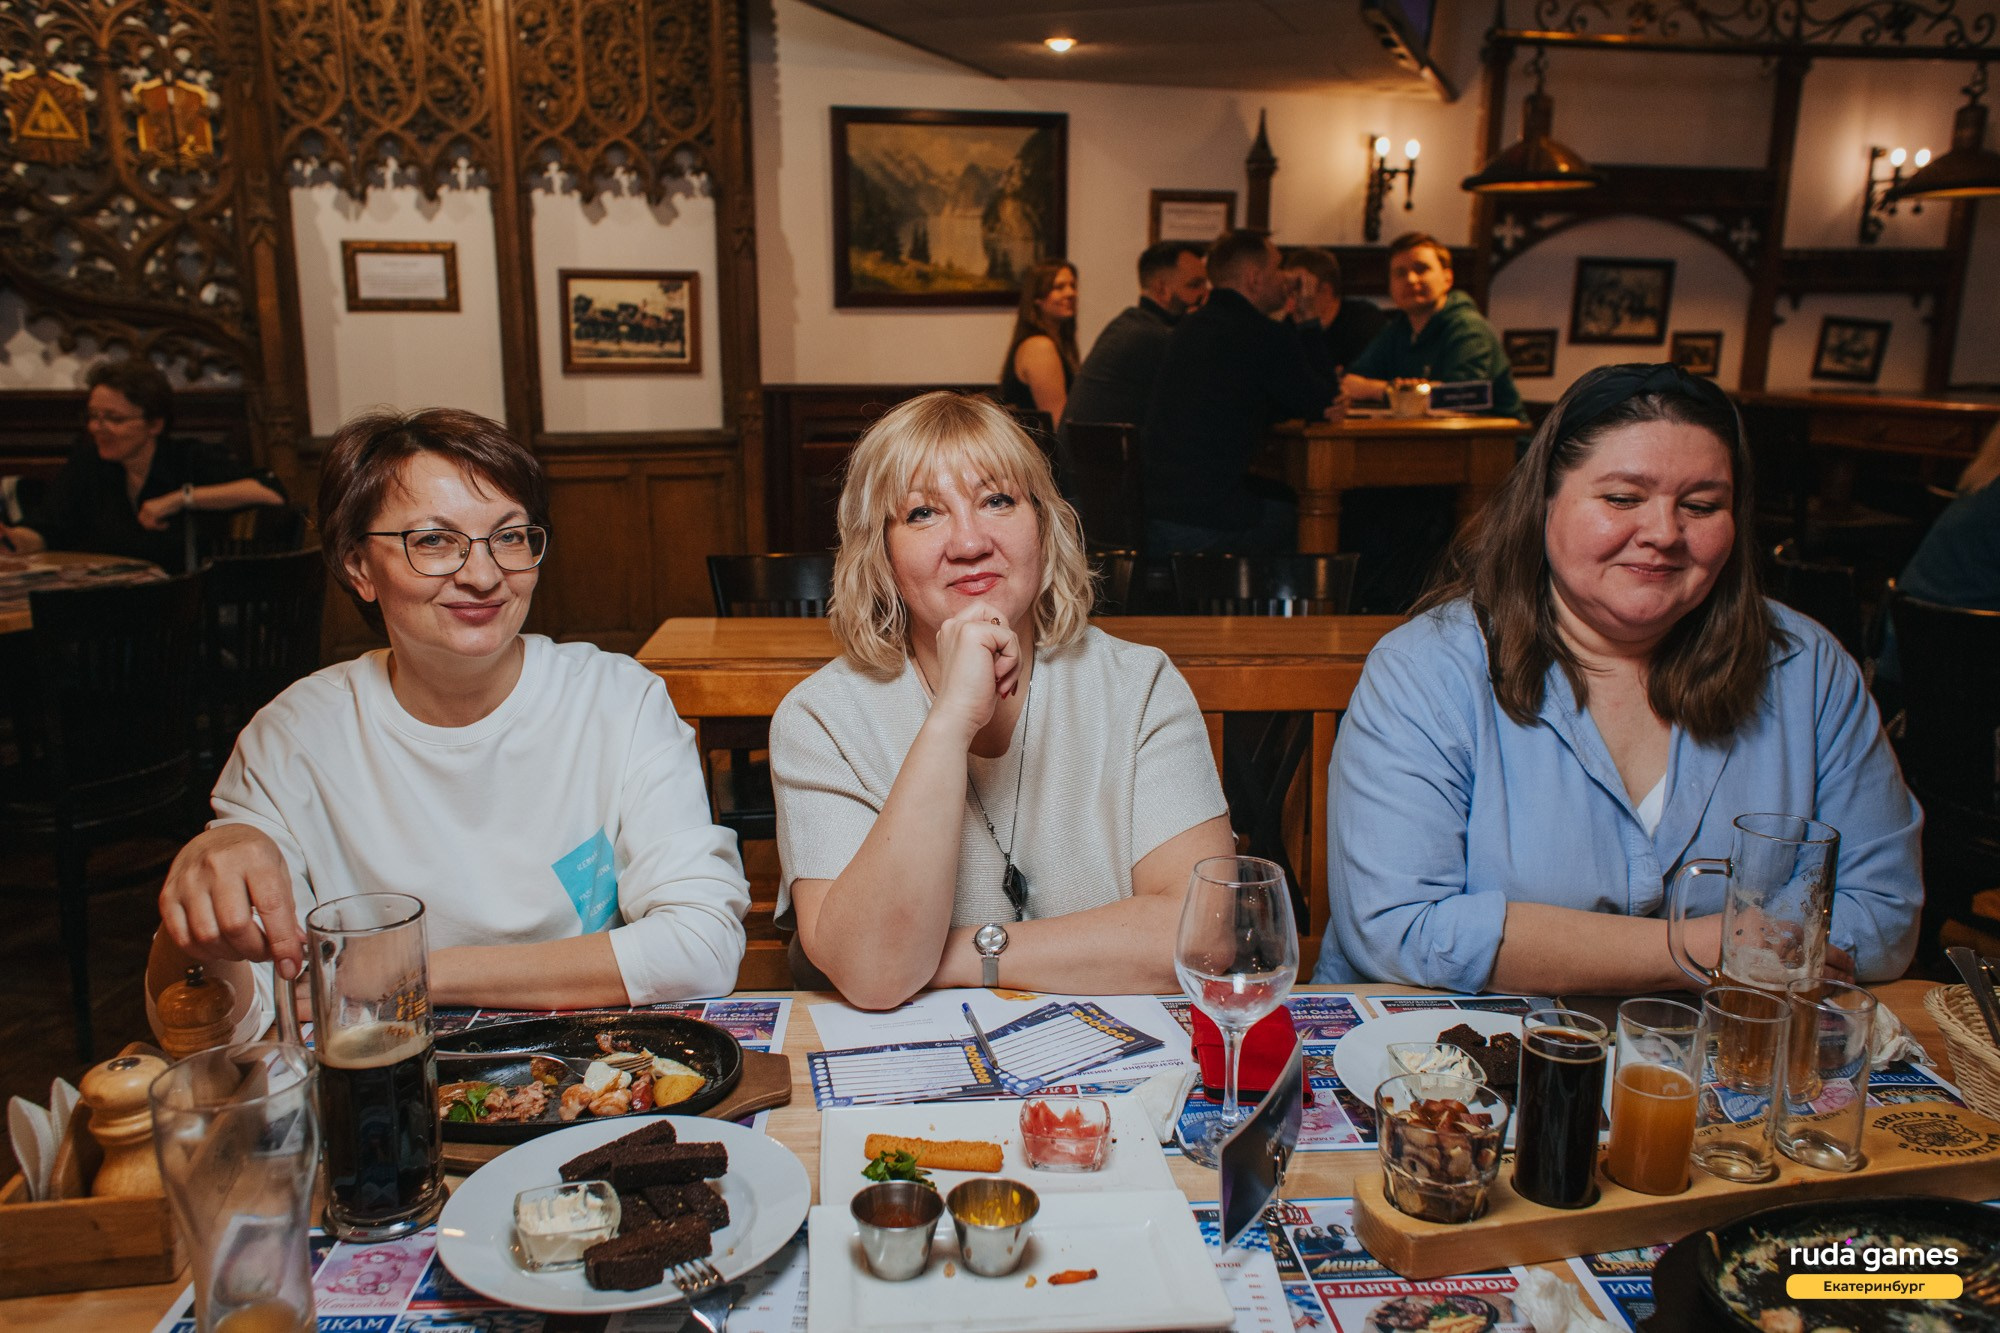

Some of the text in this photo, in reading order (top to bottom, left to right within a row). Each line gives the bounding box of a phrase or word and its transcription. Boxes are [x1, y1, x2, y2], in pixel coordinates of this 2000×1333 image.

[1064, 1086, 1073, 1095] 6
[1322, 1278, 1515, 1295] 6 ЛАНЧ В ПОДАРОК
